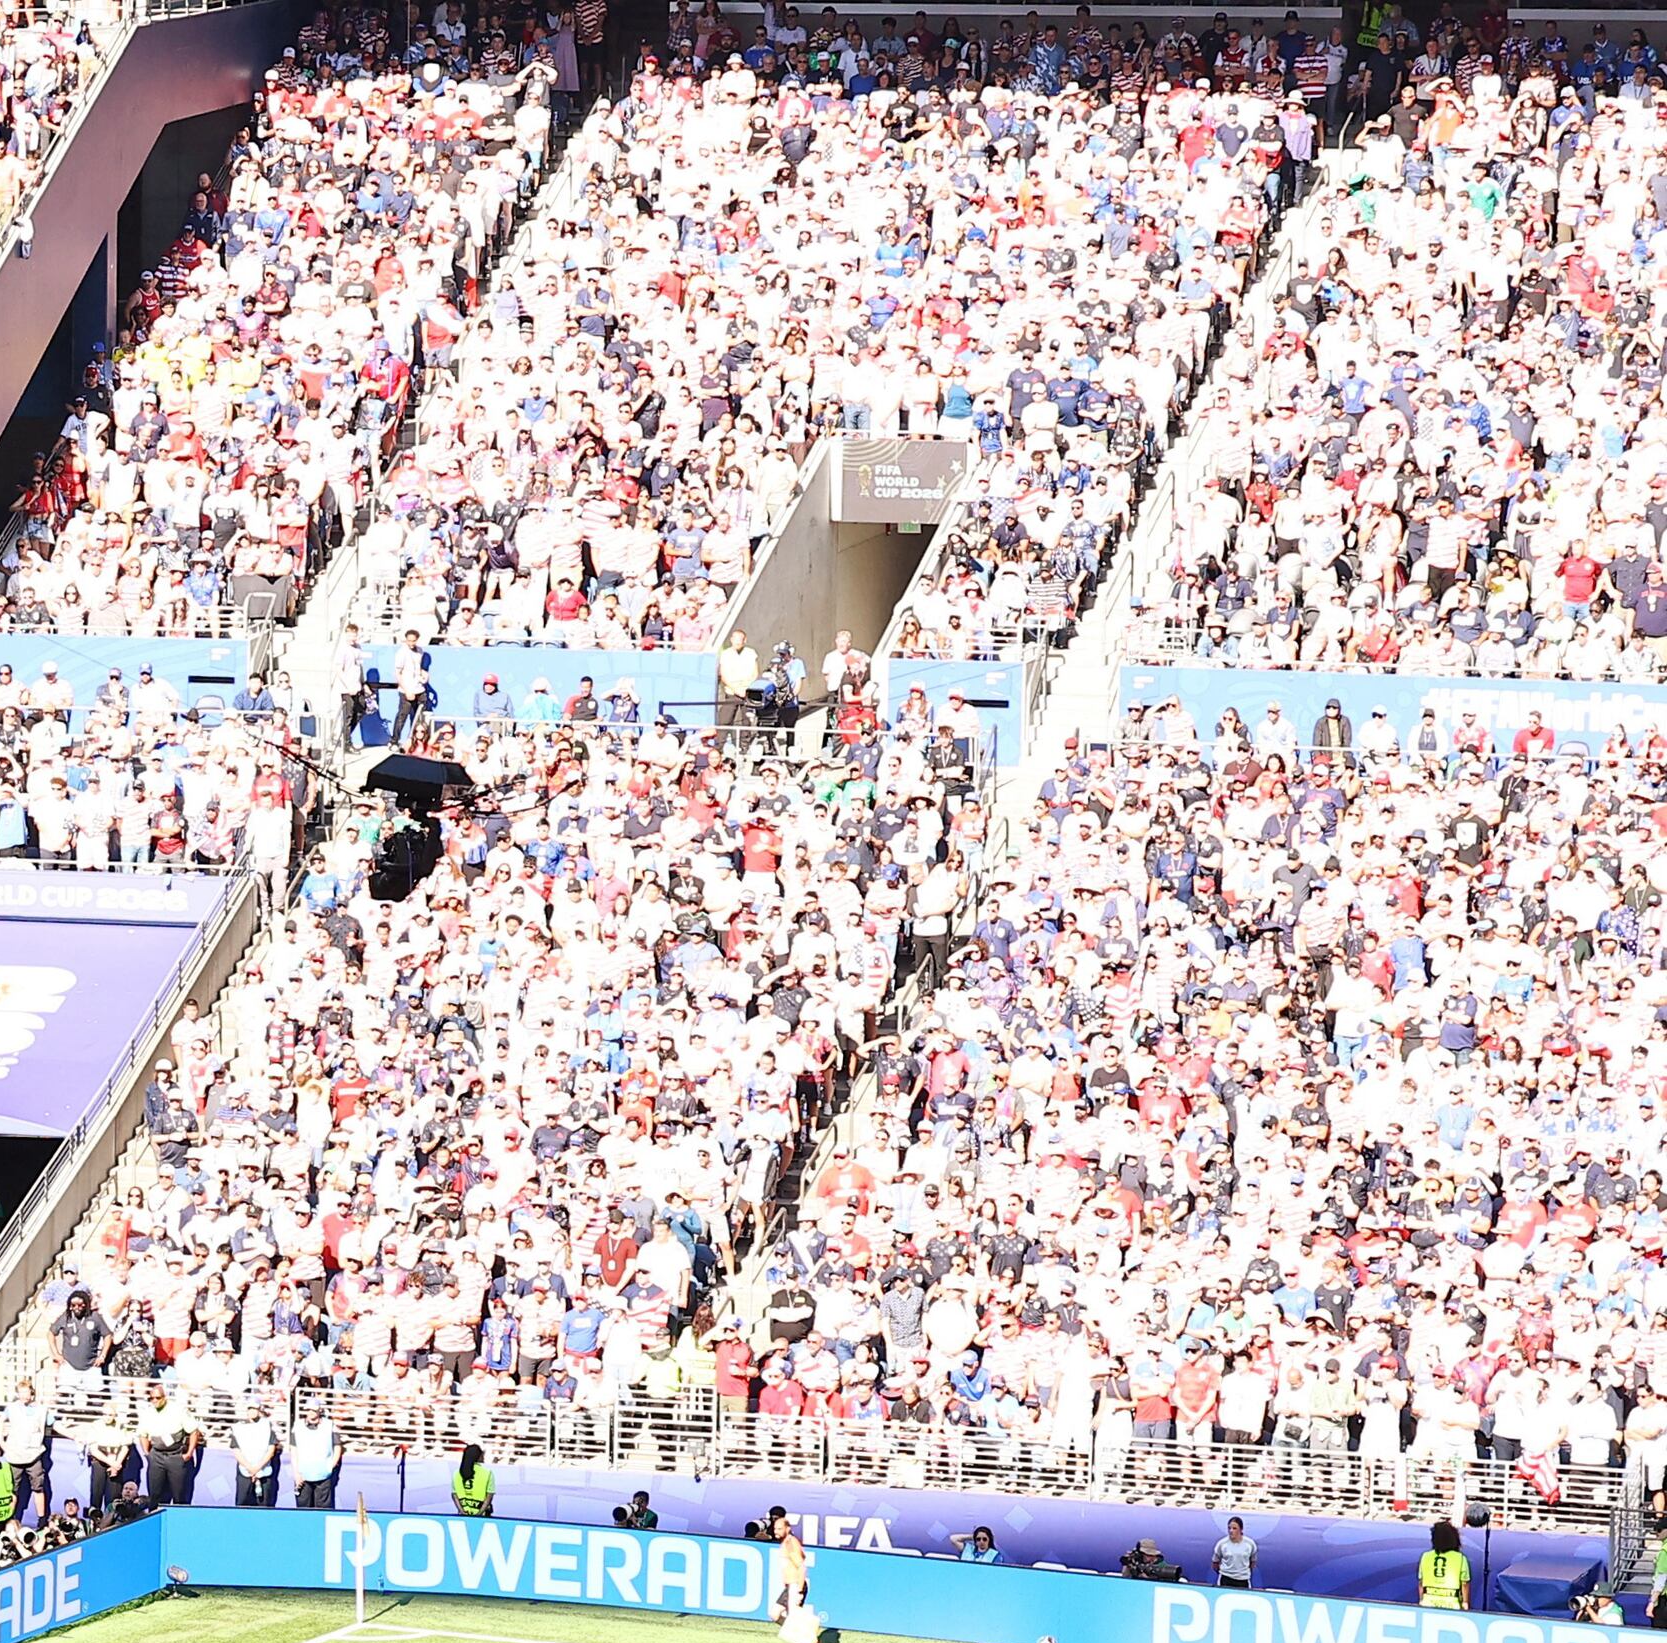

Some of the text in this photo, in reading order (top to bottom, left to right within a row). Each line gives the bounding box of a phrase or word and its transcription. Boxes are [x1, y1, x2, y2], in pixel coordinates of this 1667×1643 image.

[874, 464, 902, 476] FIFA
[874, 476, 920, 487] WORLD
[874, 487, 944, 500] CUP 2026
[40, 884, 95, 909] CUP
[96, 888, 190, 913] 2026
